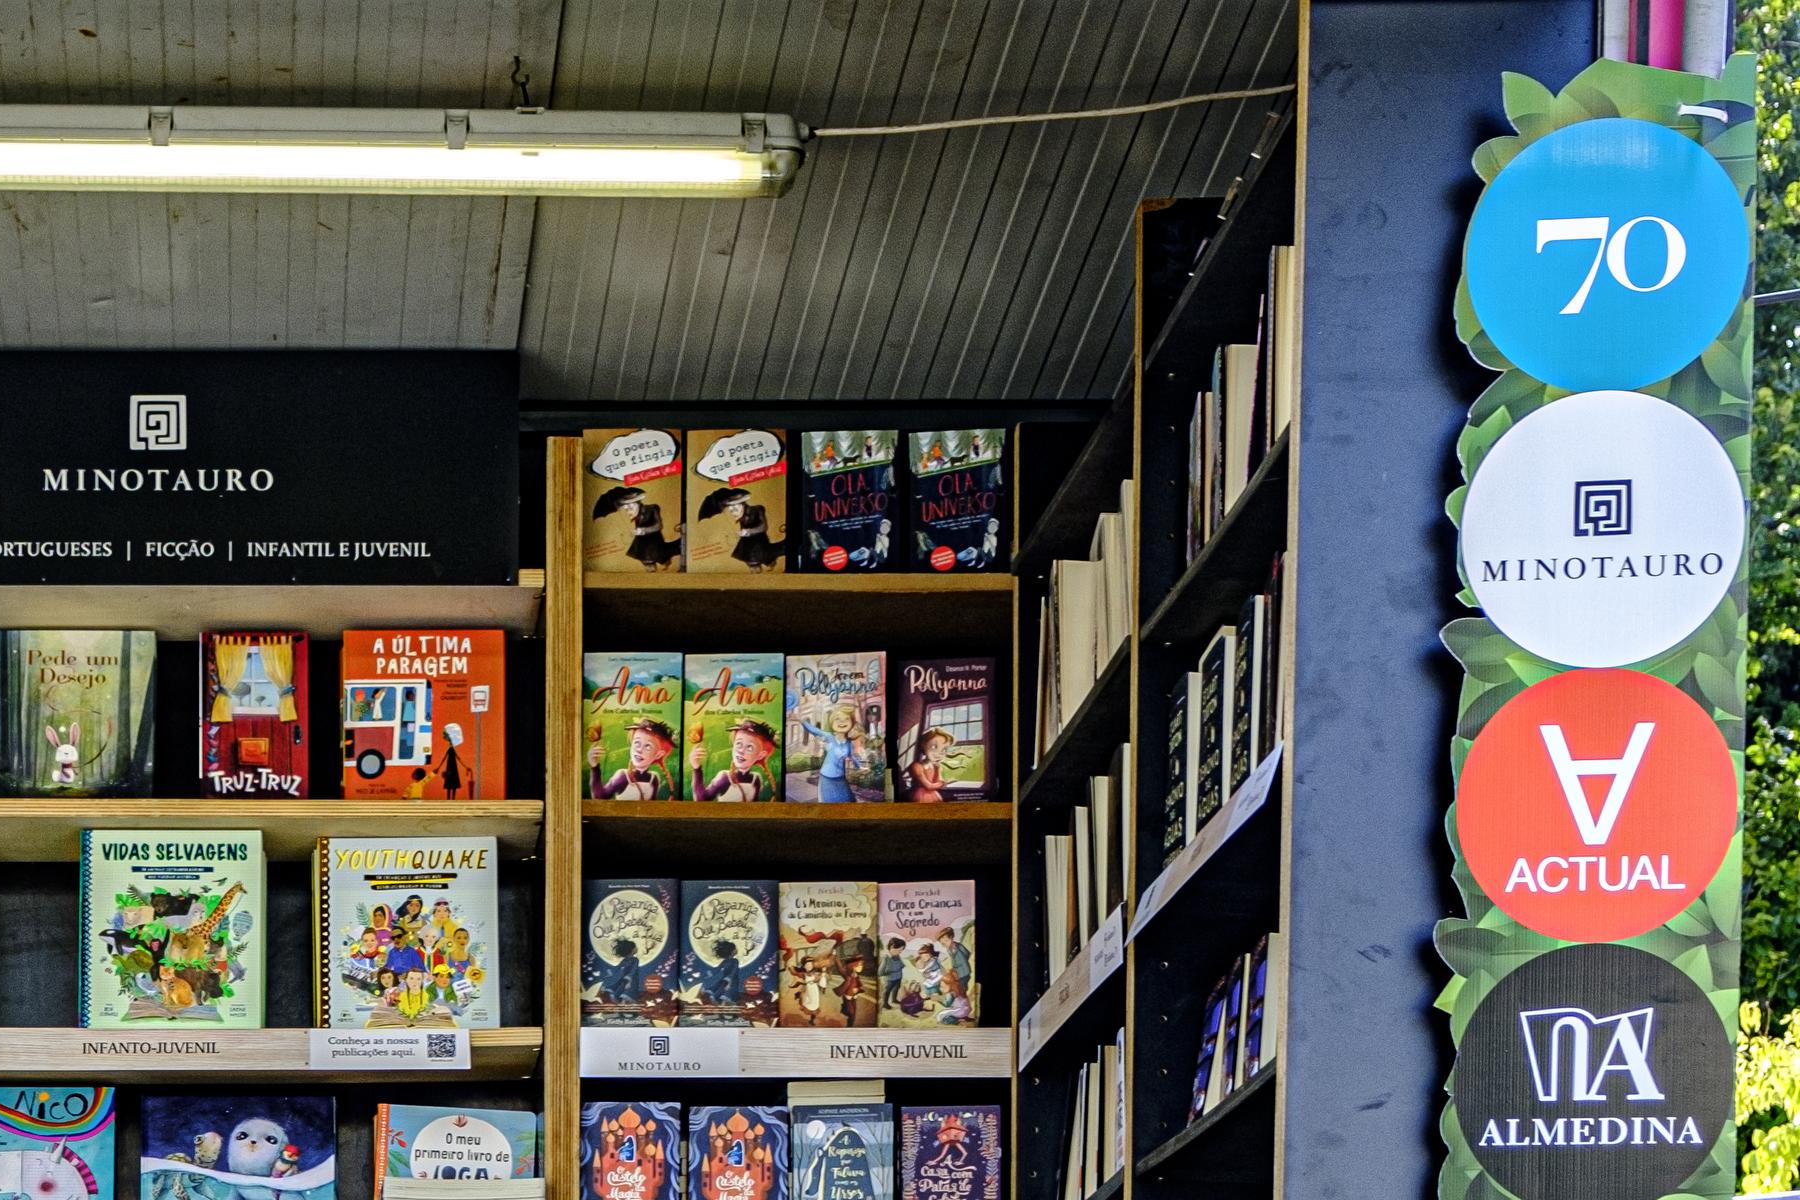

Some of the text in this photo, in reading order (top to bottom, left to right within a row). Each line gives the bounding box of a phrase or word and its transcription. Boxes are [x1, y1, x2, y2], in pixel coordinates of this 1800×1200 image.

[1536, 216, 1687, 315] 70
[624, 439, 660, 457] poeta
[729, 440, 764, 457] poeta
[604, 450, 674, 473] que fingia
[709, 450, 779, 474] que fingia
[43, 467, 275, 492] MINOTAURO
[145, 537, 215, 561] FICÇÃO
[247, 541, 335, 558] INFANTIL
[339, 542, 349, 558] E
[353, 541, 431, 562] JUVENIL
[1482, 552, 1723, 583] MINOTAURO
[373, 633, 472, 656] A ÚLTIMA
[27, 648, 119, 667] Pede um
[376, 656, 468, 678] PARAGEM
[38, 667, 107, 690] Desejo
[590, 665, 677, 715] Ana
[795, 667, 879, 703] Pollyanna
[904, 664, 988, 700] Pollyanna
[692, 666, 777, 716] Ana
[209, 767, 302, 796] TRUZ-TRUZ
[102, 842, 248, 862] VIDAS SELVAGENS
[335, 847, 489, 871] YOUTHQUAKE
[1504, 855, 1686, 893] ACTUAL
[918, 898, 963, 910] Crianças
[895, 912, 940, 937] Segredo
[82, 1040, 220, 1057] INFANTO-JUVENIL
[327, 1036, 419, 1049] Conheça as nossas
[332, 1046, 389, 1059] publicações
[830, 1044, 968, 1059] INFANTO-JUVENIL
[618, 1062, 701, 1071] MINOTAURO
[456, 1134, 481, 1147] meu
[1479, 1115, 1703, 1147] ALMEDINA
[415, 1147, 510, 1165] primeiro livro de
